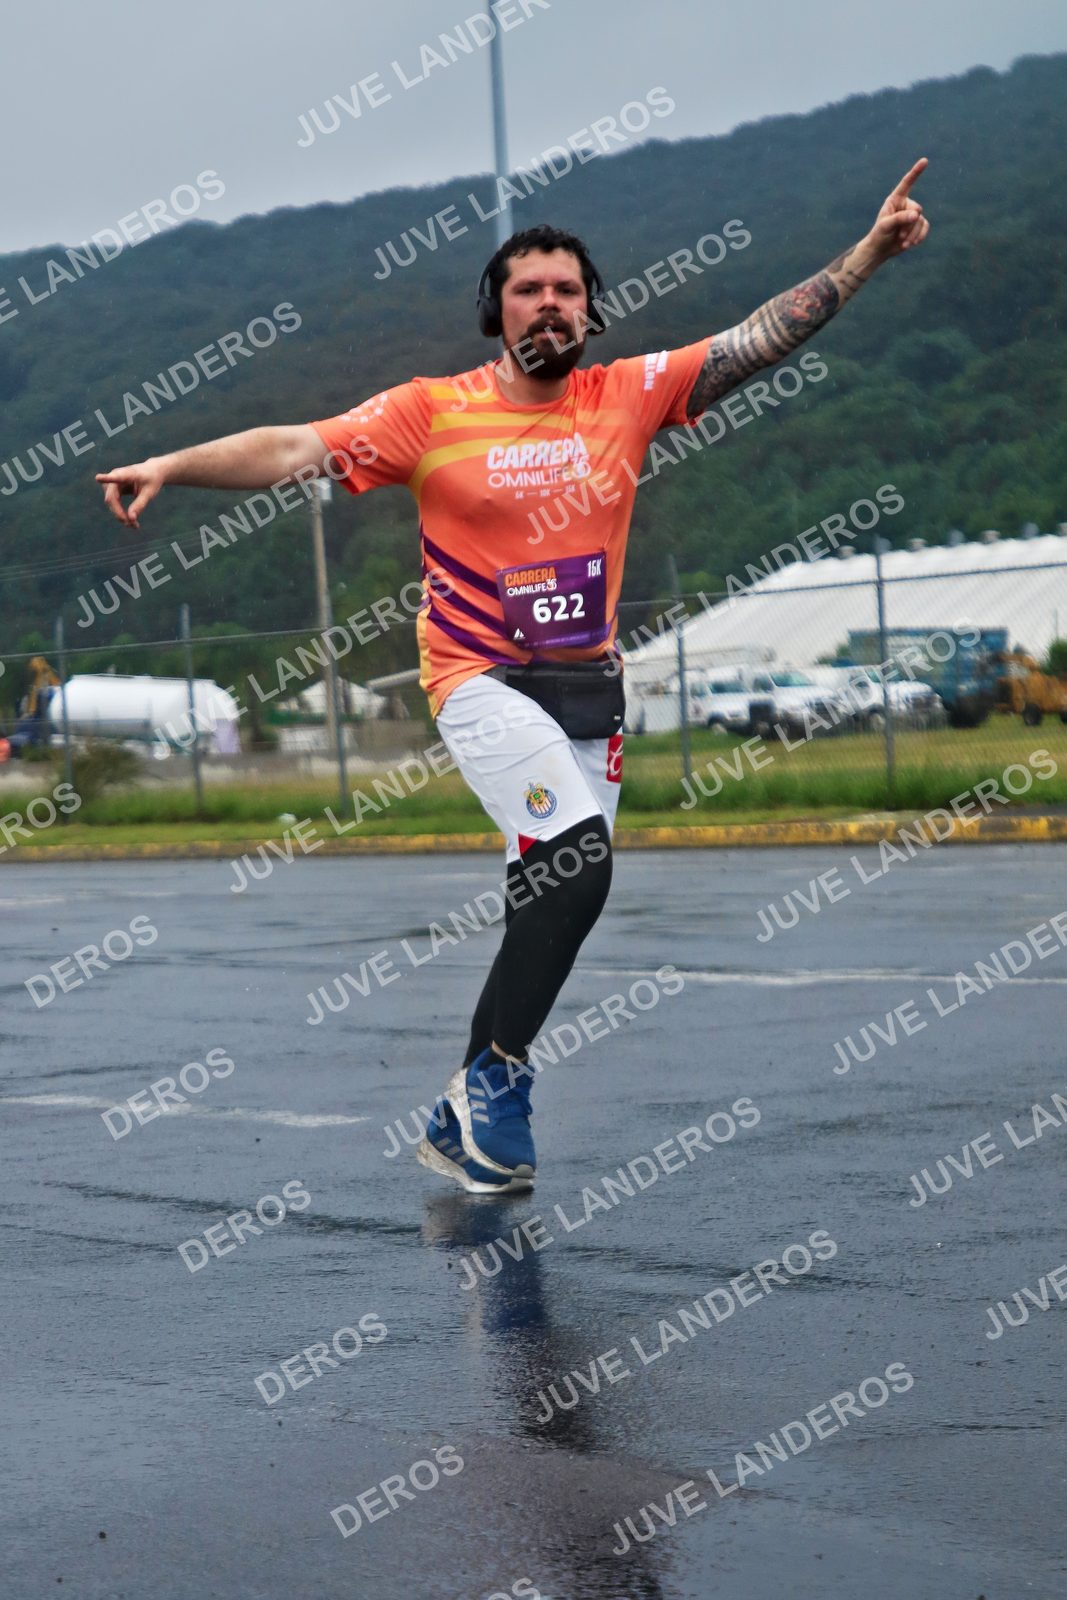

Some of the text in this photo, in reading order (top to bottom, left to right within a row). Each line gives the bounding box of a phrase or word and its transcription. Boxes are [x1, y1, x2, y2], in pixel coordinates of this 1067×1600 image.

[487, 432, 589, 470] CARRERA
[488, 466, 572, 489] OMNILIFE
[504, 566, 557, 587] CARRERA
[507, 582, 547, 597] OMNILIFE
[532, 592, 586, 624] 622
